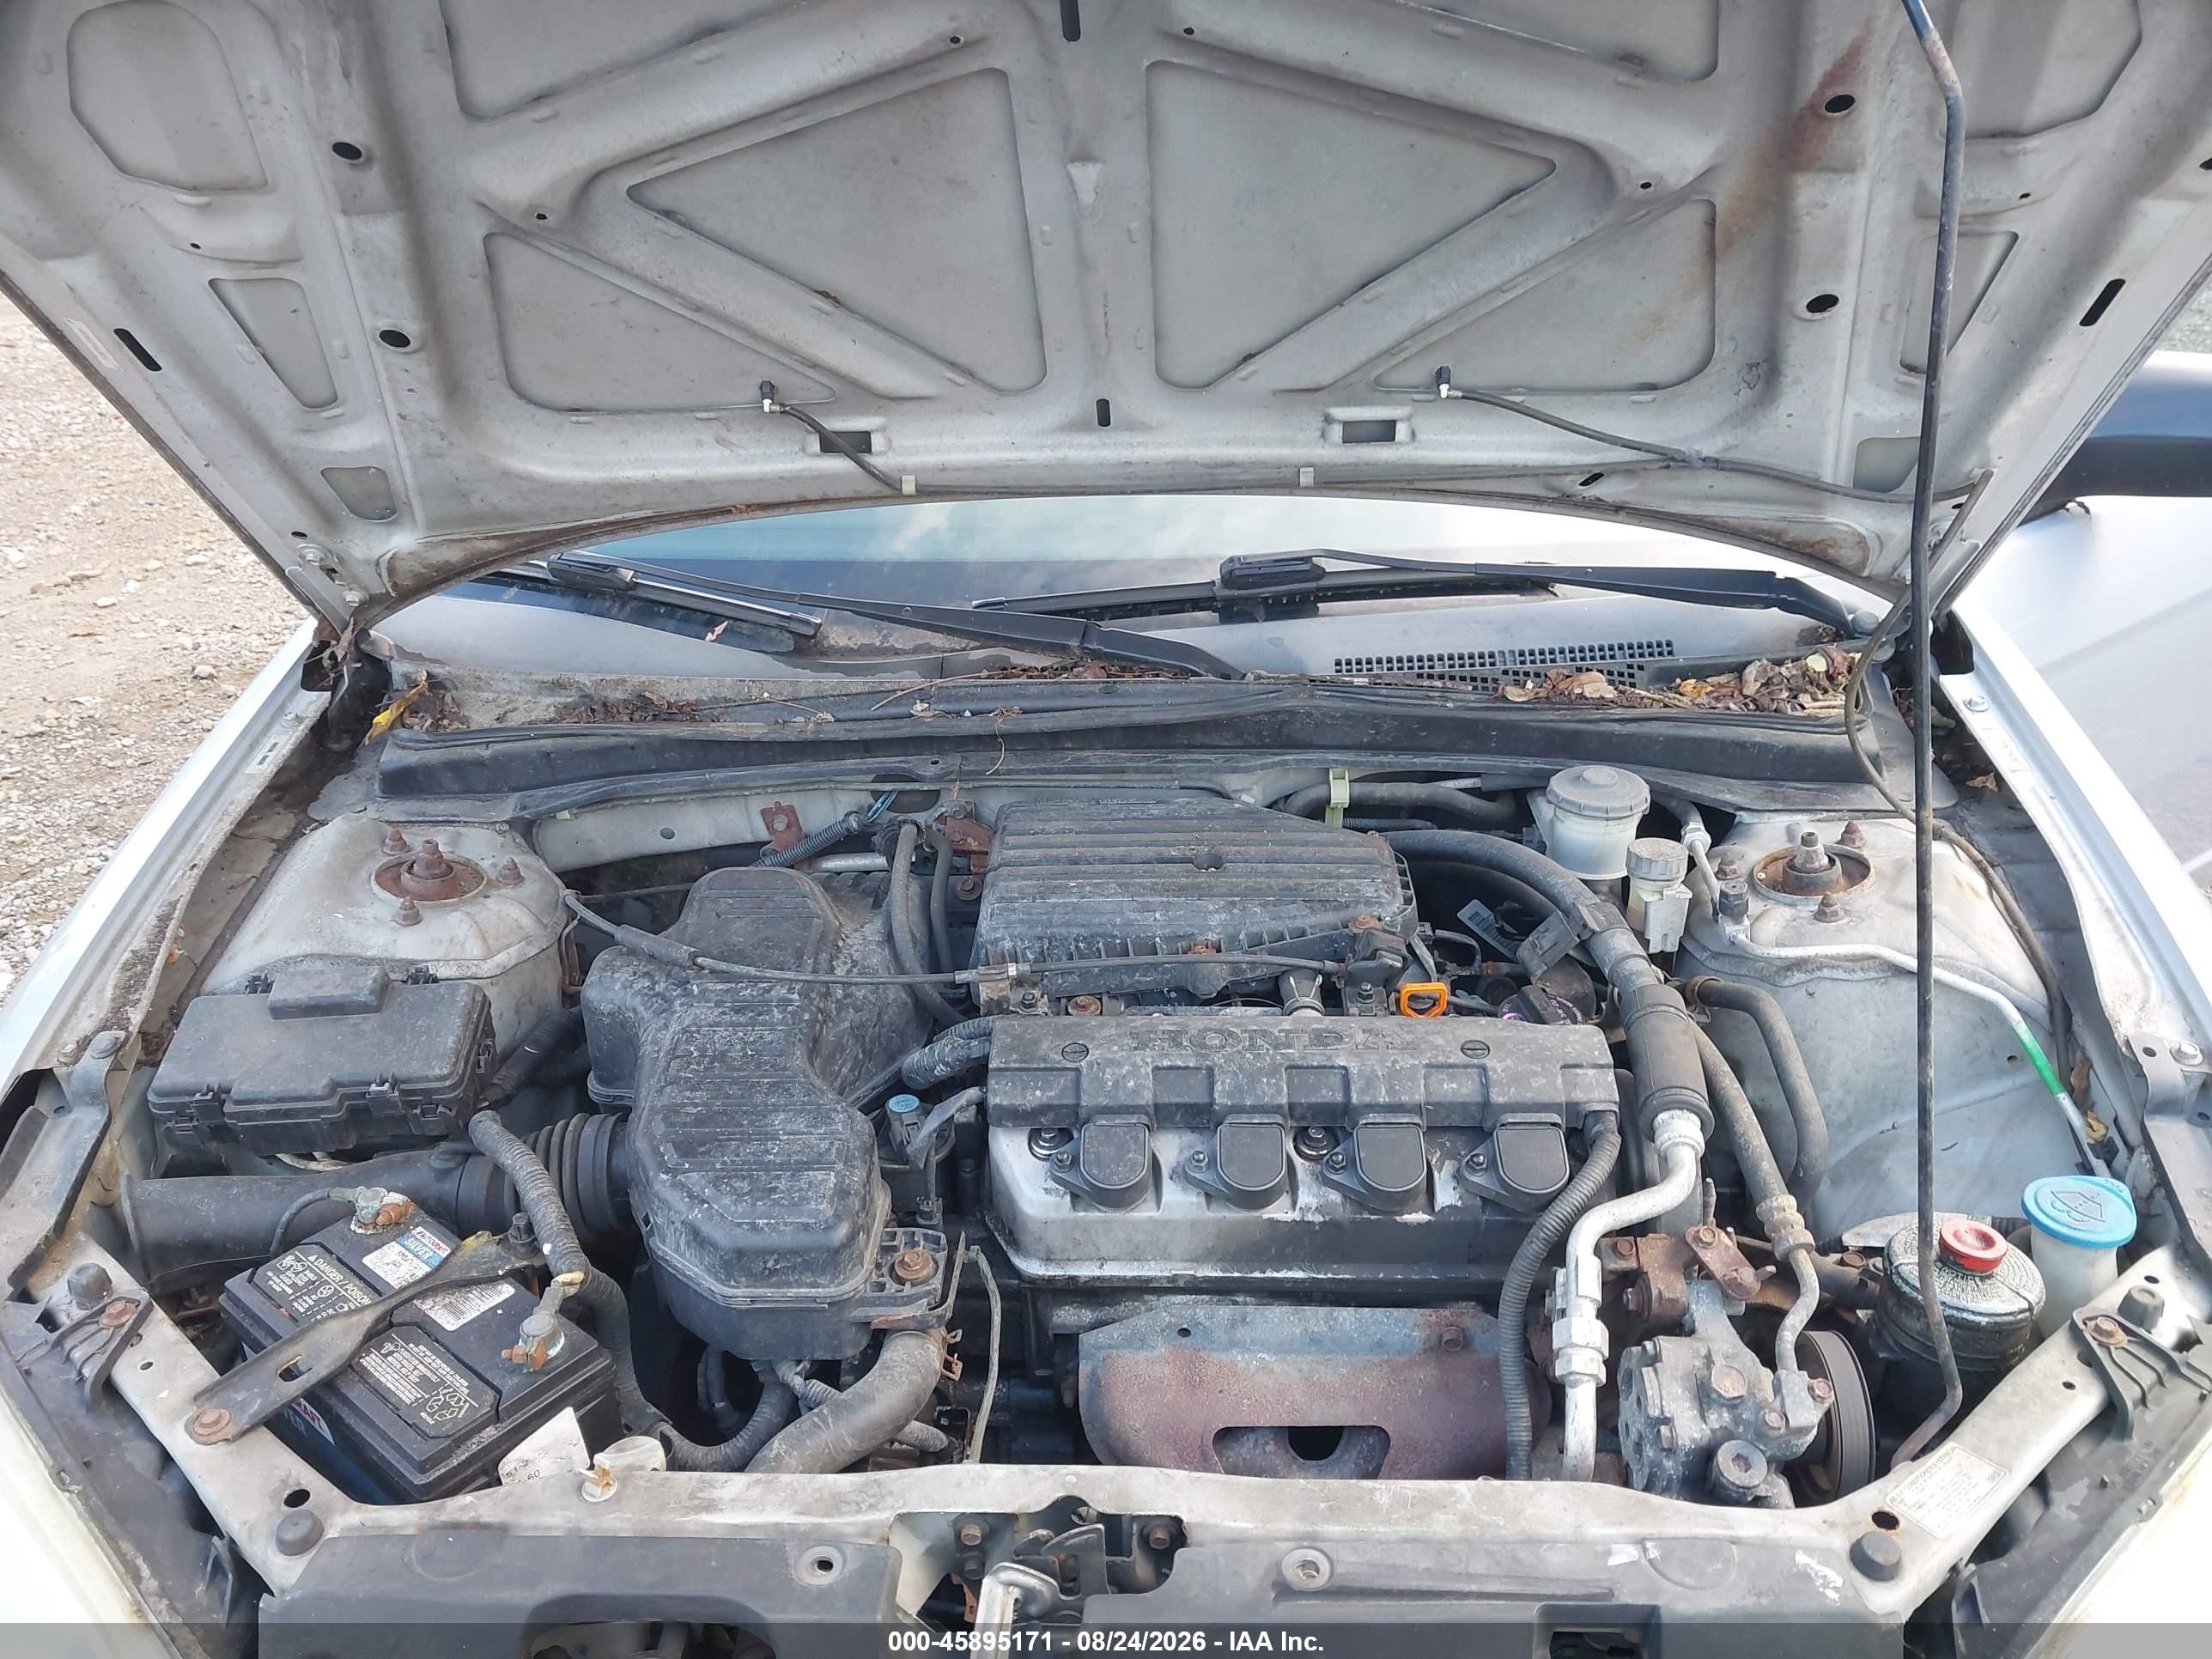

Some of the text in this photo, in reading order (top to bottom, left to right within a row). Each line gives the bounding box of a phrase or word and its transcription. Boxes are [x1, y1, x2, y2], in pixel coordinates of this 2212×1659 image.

[1129, 1028, 1418, 1053] HONDA
[404, 1237, 433, 1260] SILVER
[313, 1258, 343, 1284] DANGER
[343, 1283, 372, 1305] POISON
